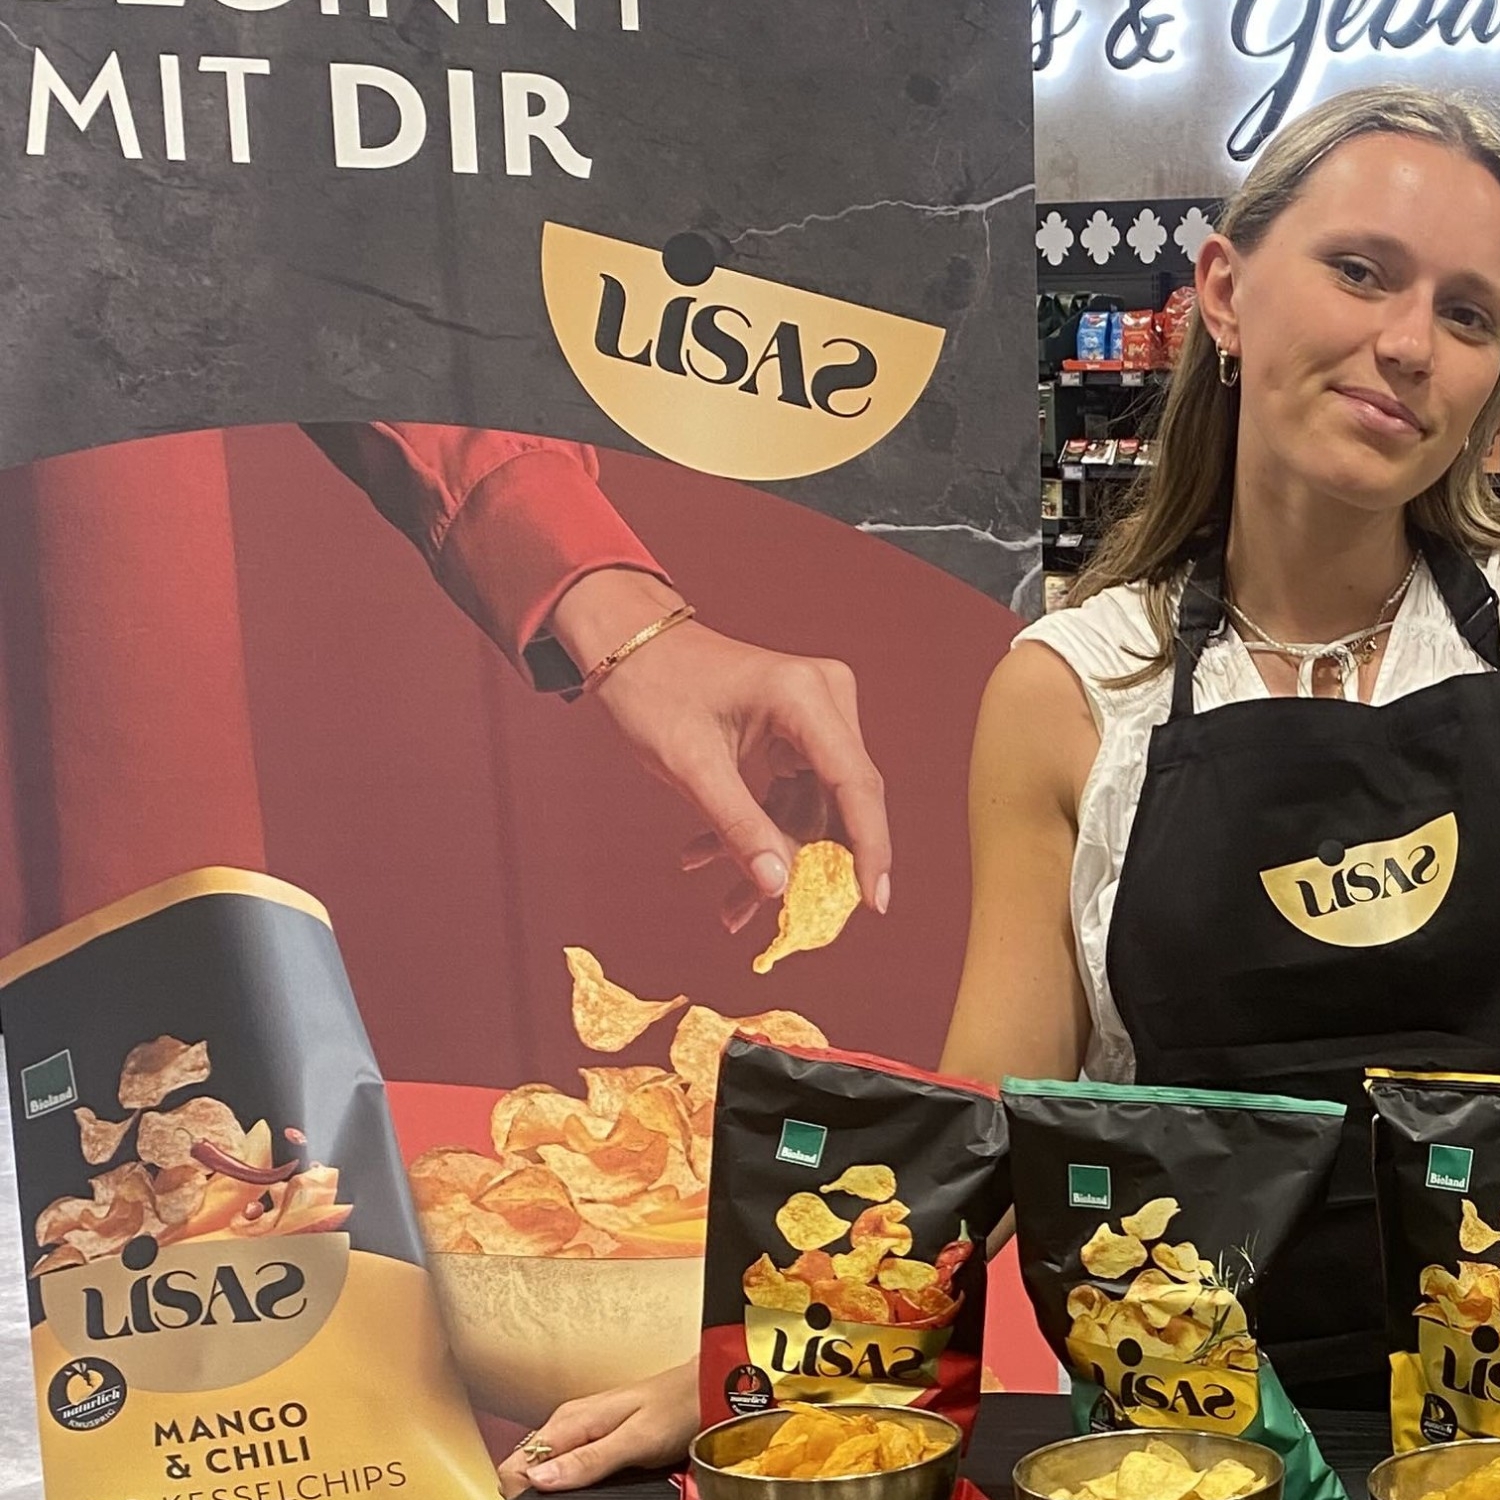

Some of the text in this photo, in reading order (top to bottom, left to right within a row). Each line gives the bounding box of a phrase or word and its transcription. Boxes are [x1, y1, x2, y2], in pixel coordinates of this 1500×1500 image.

[26, 47, 593, 179] MIT DIR
[30, 1088, 74, 1114] Bioland
[781, 1146, 818, 1163] Bioland
[1430, 1173, 1466, 1188] Bioland
[1073, 1193, 1107, 1205] Bioland
[154, 1402, 308, 1446] MANGO
[166, 1435, 311, 1479] & CHILI
